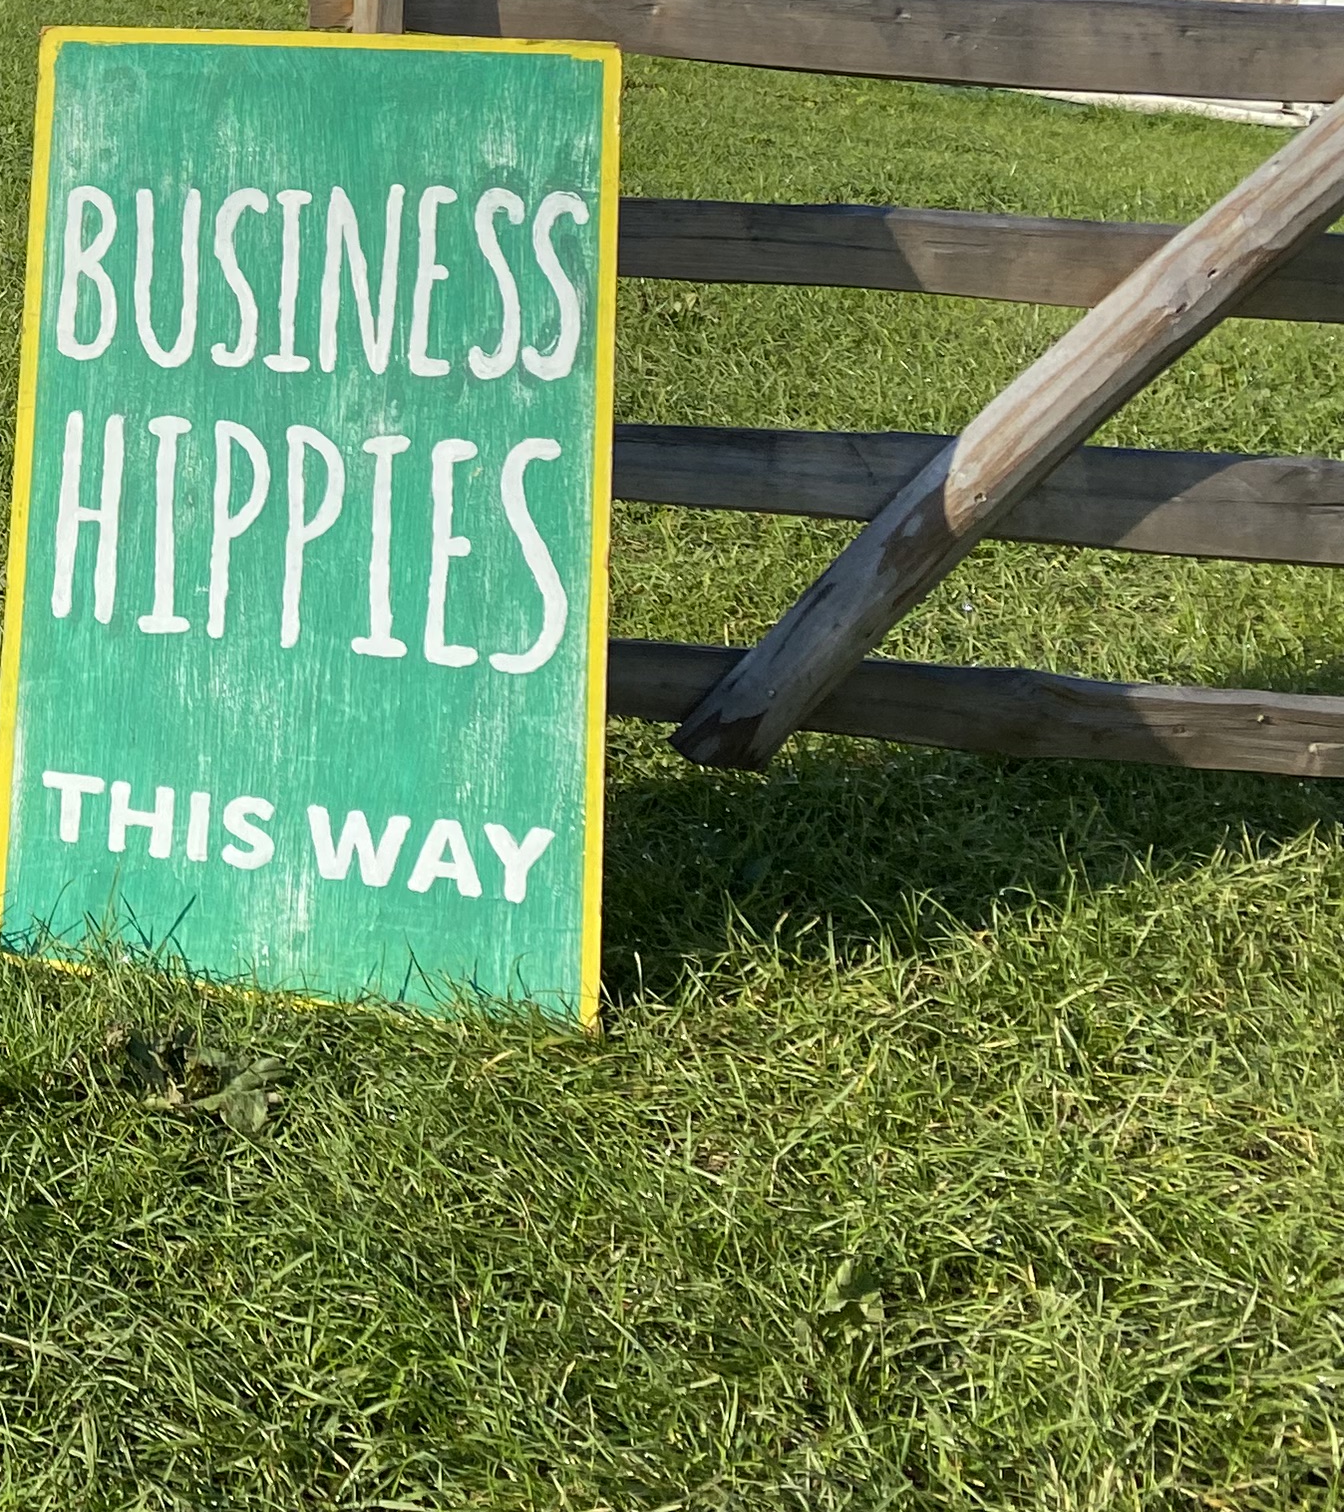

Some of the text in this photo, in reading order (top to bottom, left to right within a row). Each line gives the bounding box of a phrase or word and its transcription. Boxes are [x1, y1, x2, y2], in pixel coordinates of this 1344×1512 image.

[56, 183, 590, 381] BUSINESS
[51, 410, 568, 675] HIPPIES
[41, 770, 556, 904] THIS WAY
